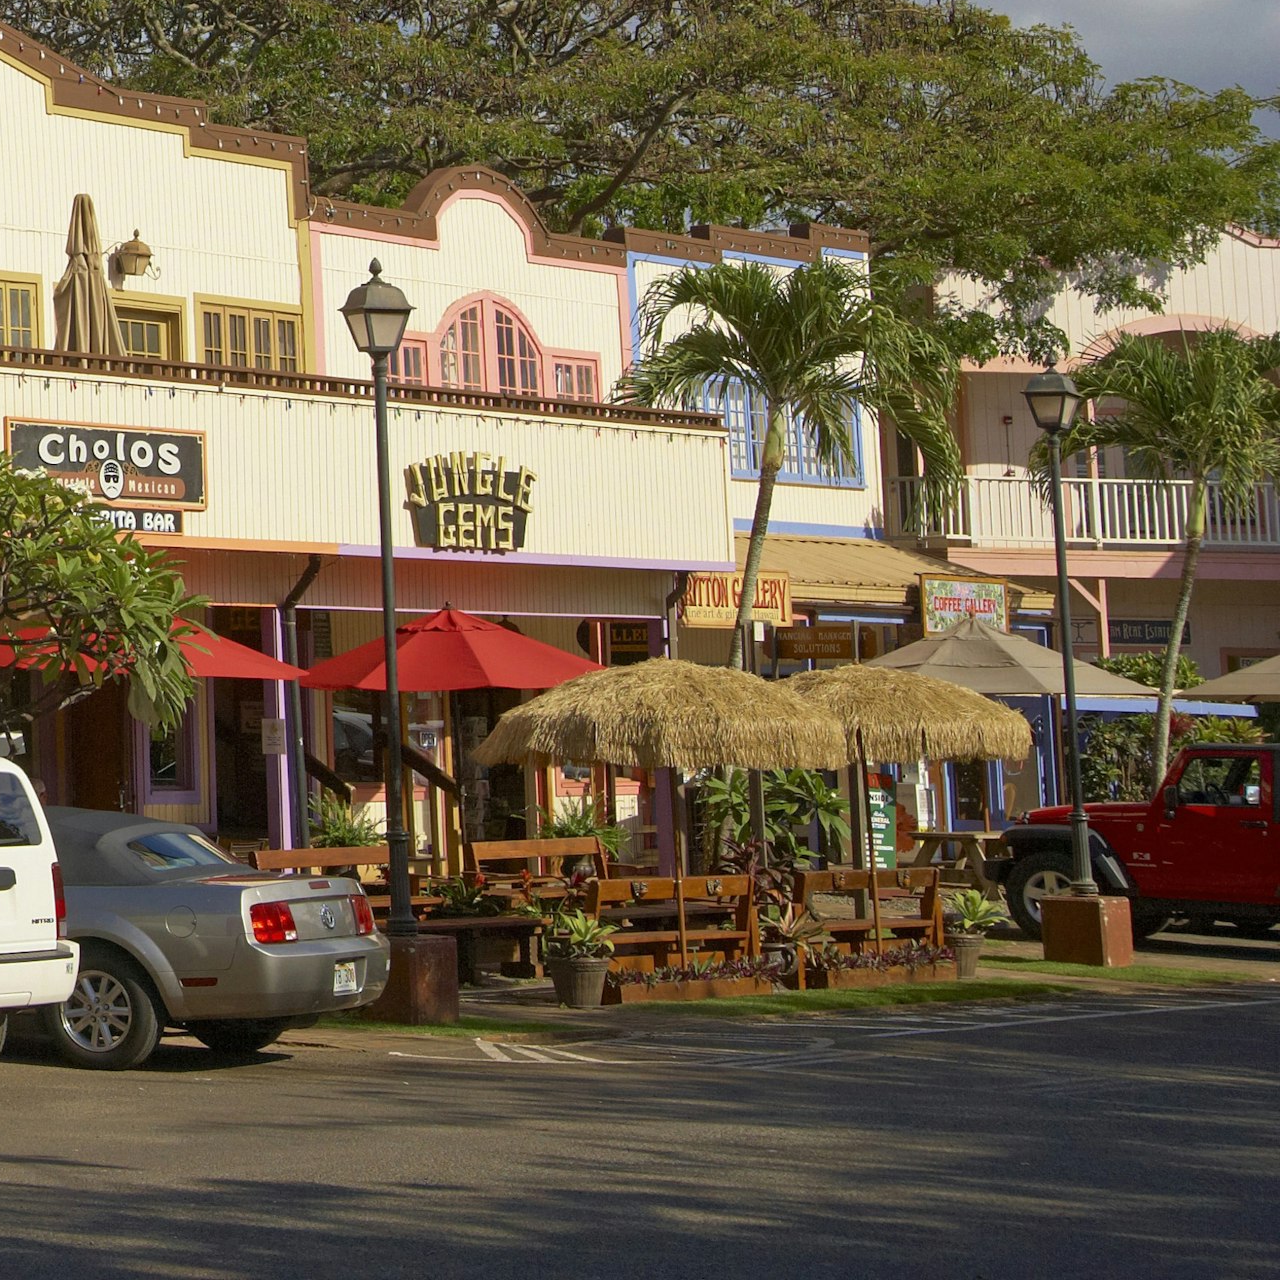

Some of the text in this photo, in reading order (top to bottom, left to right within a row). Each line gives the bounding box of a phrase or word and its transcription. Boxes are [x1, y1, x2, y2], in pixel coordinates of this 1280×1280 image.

[38, 432, 181, 475] Cholos
[128, 479, 177, 495] Mexican
[408, 451, 537, 513] JUNGLE
[143, 512, 176, 533] BAR
[437, 502, 514, 550] GEMS
[933, 596, 962, 612] COFFEE
[793, 642, 841, 654] SOLUTIONS
[870, 793, 889, 801] NSIDE
